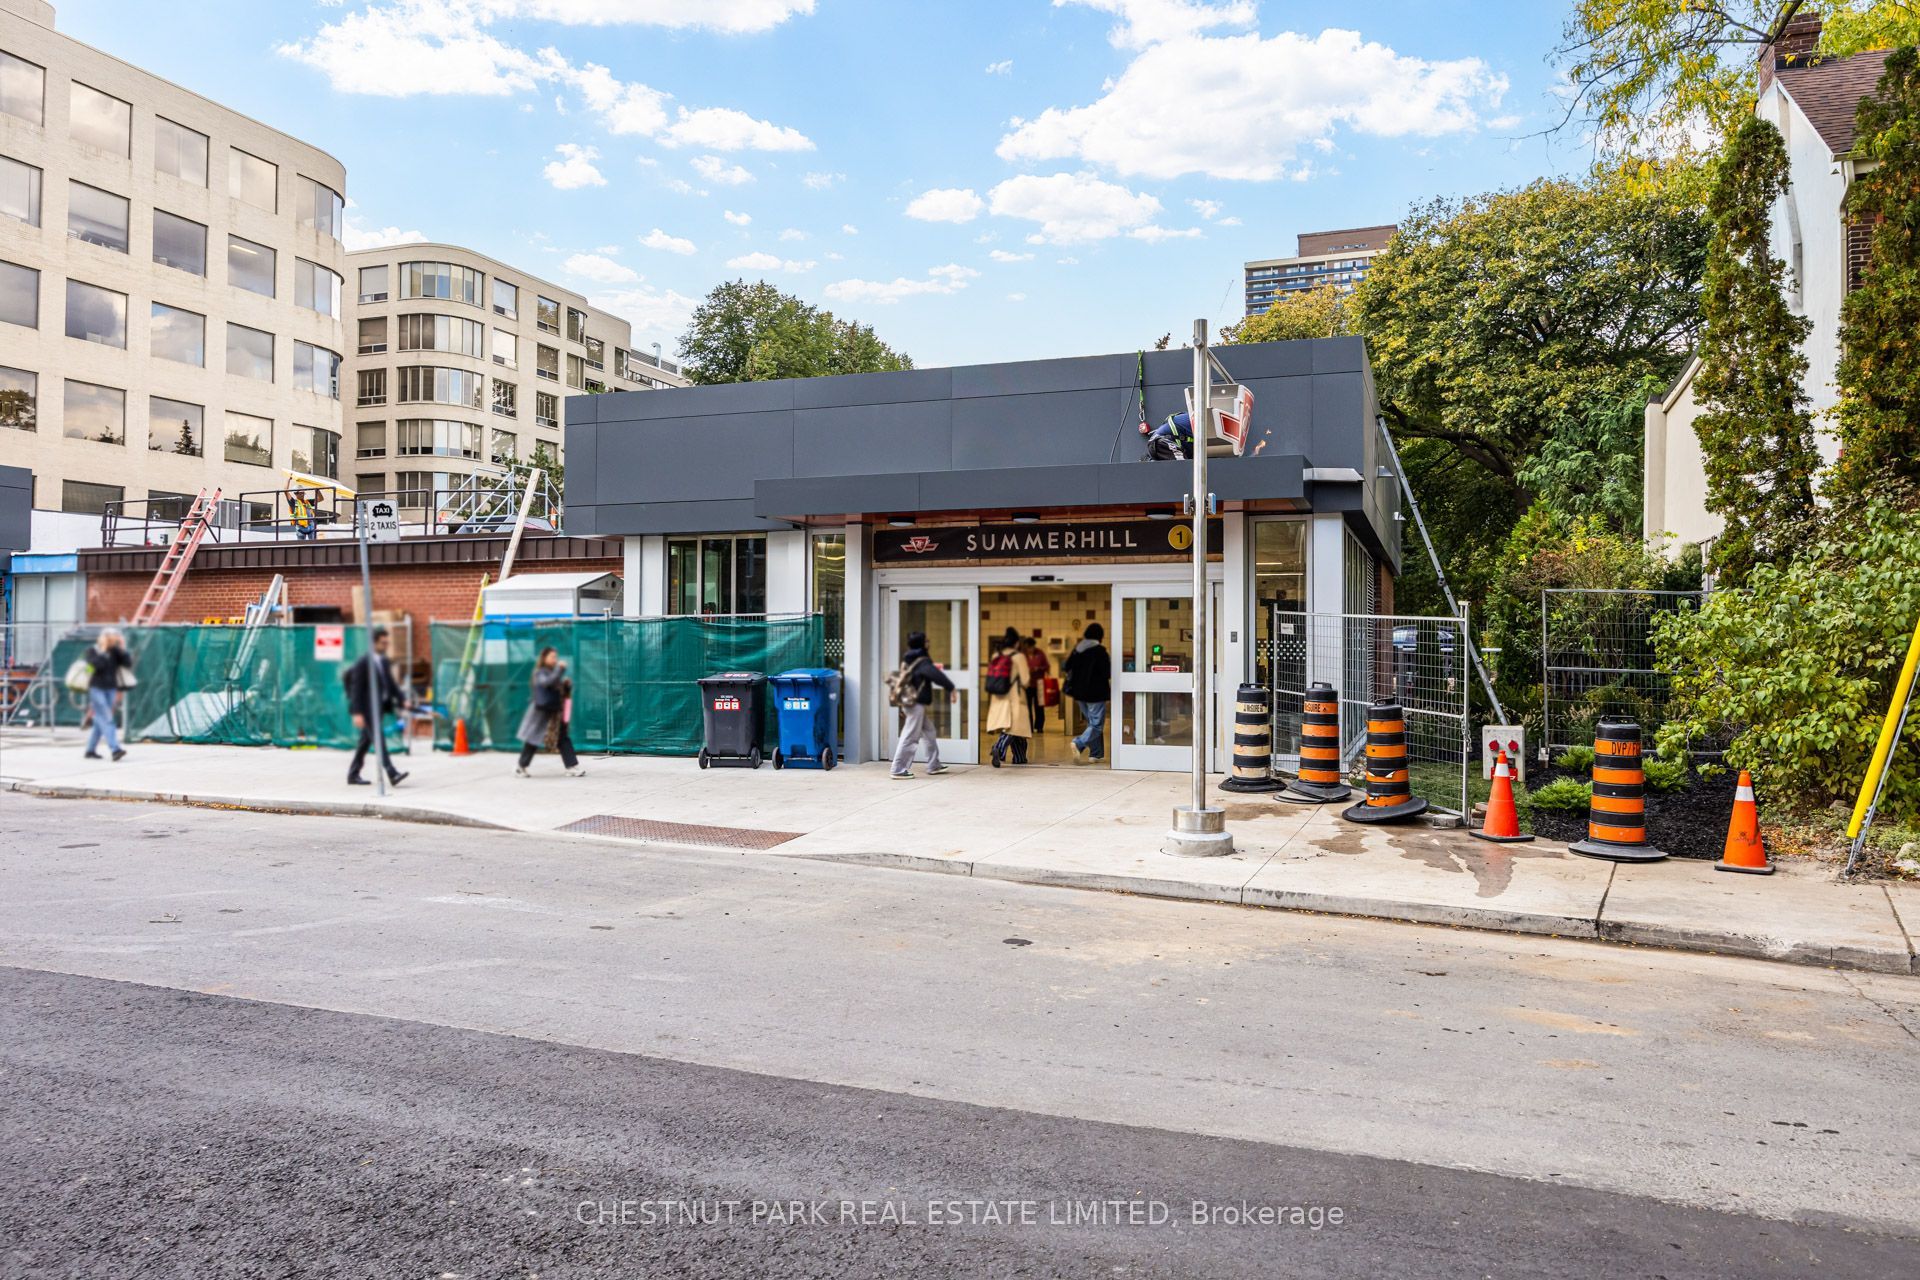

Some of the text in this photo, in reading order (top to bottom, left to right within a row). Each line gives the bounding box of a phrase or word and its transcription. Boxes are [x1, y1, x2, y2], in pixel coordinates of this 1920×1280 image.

[370, 521, 397, 530] 2 TAXIS
[967, 530, 1137, 551] SUMMERHILL
